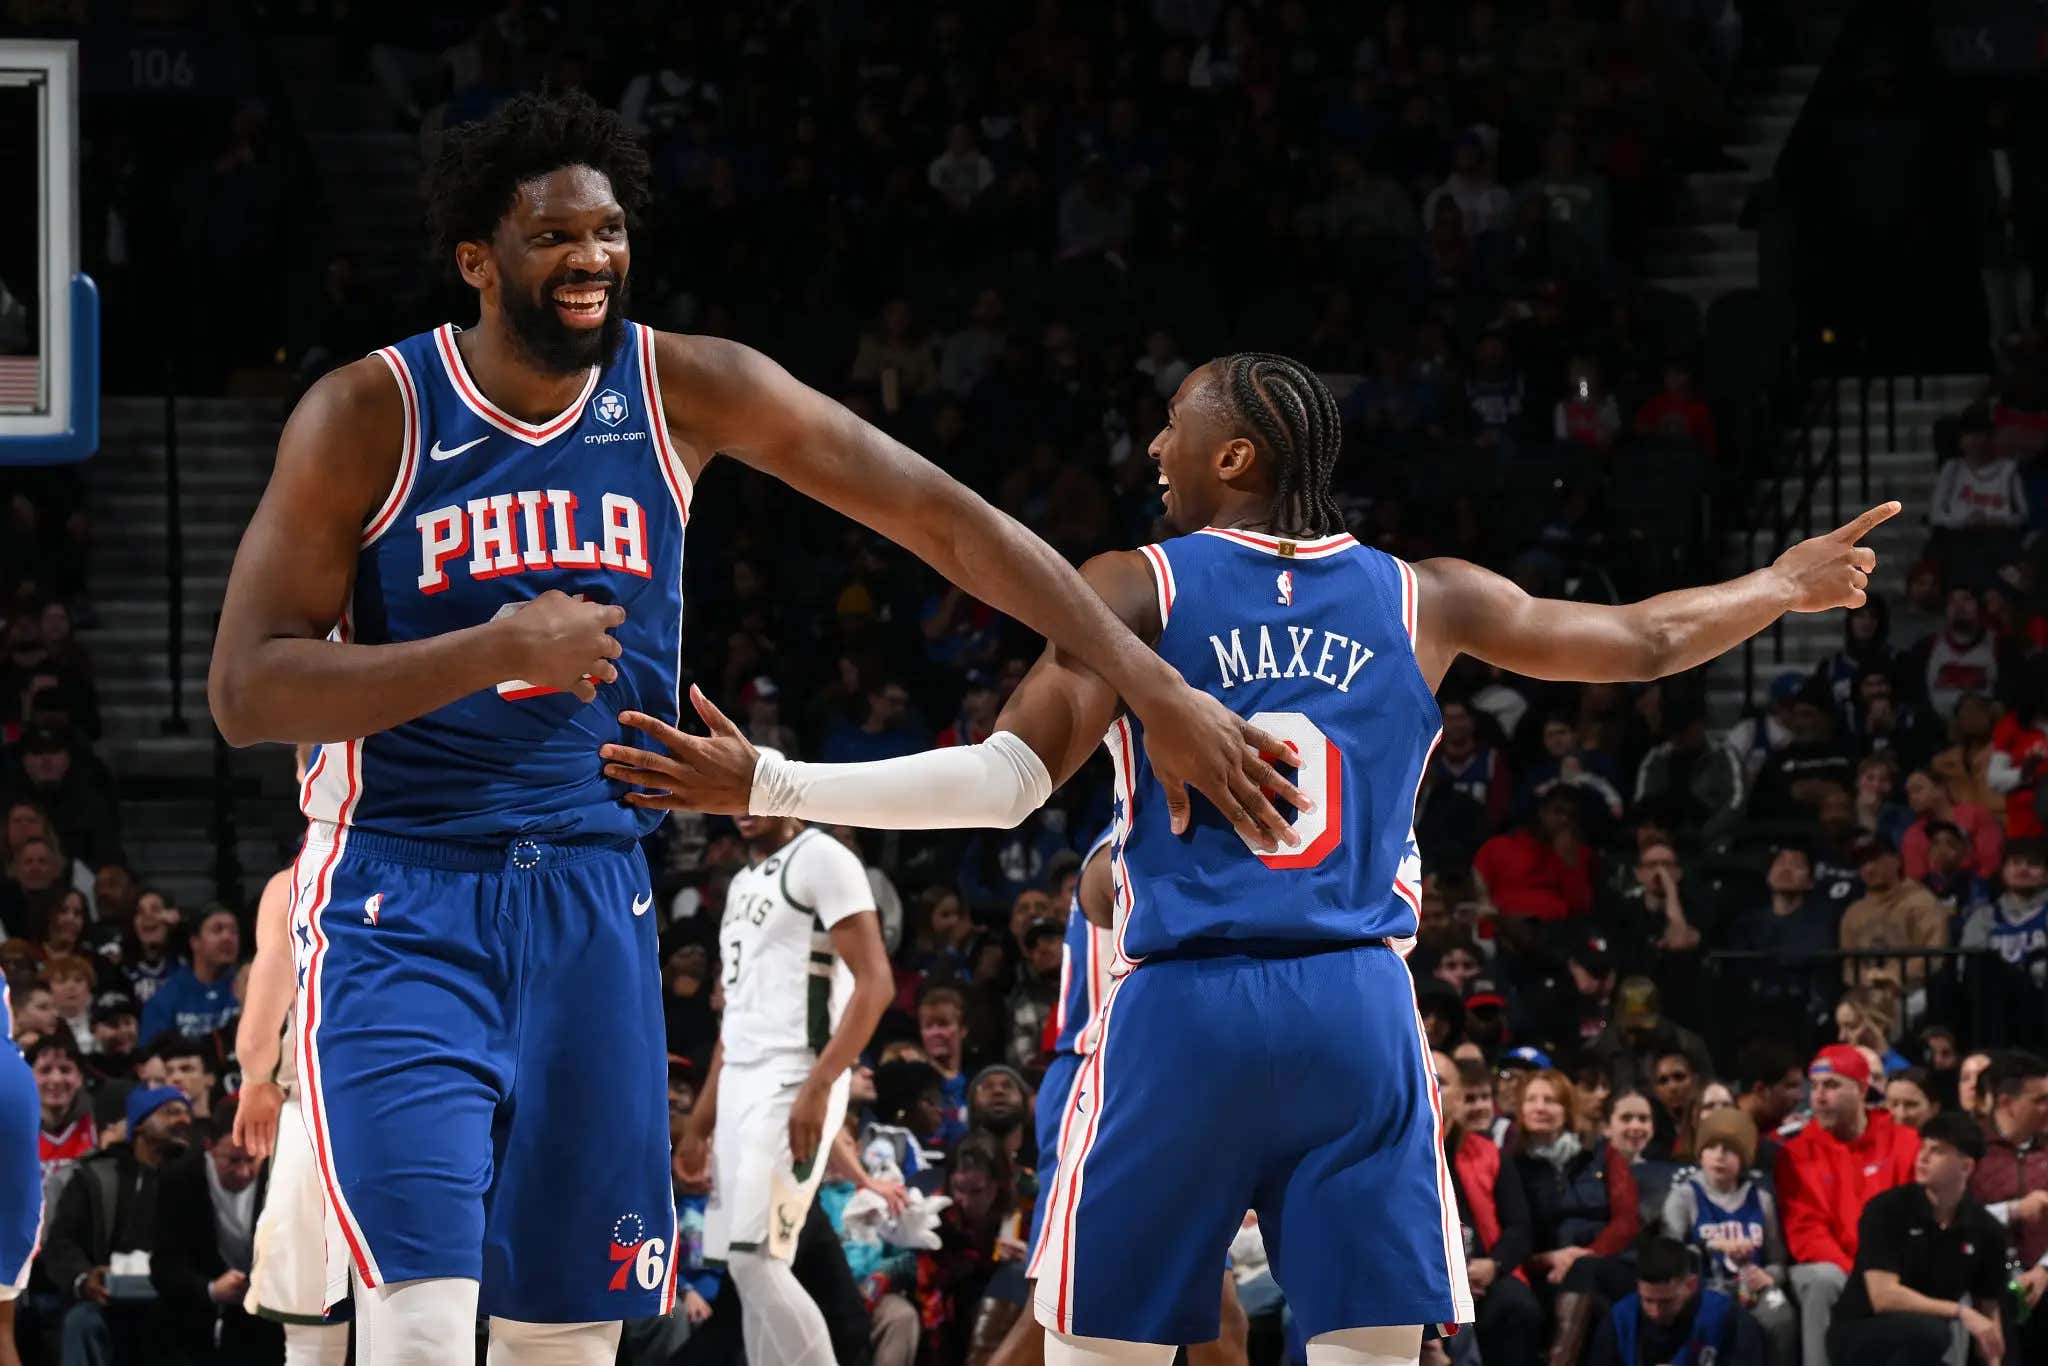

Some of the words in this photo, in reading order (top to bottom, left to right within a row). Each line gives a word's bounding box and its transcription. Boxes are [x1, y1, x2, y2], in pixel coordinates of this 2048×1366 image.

[128, 48, 194, 88] 106
[584, 431, 646, 444] crypto.com
[416, 490, 652, 595] PHILA
[1209, 625, 1374, 693] MAXEY
[1234, 712, 1342, 870] 0
[608, 1237, 665, 1292] 76
